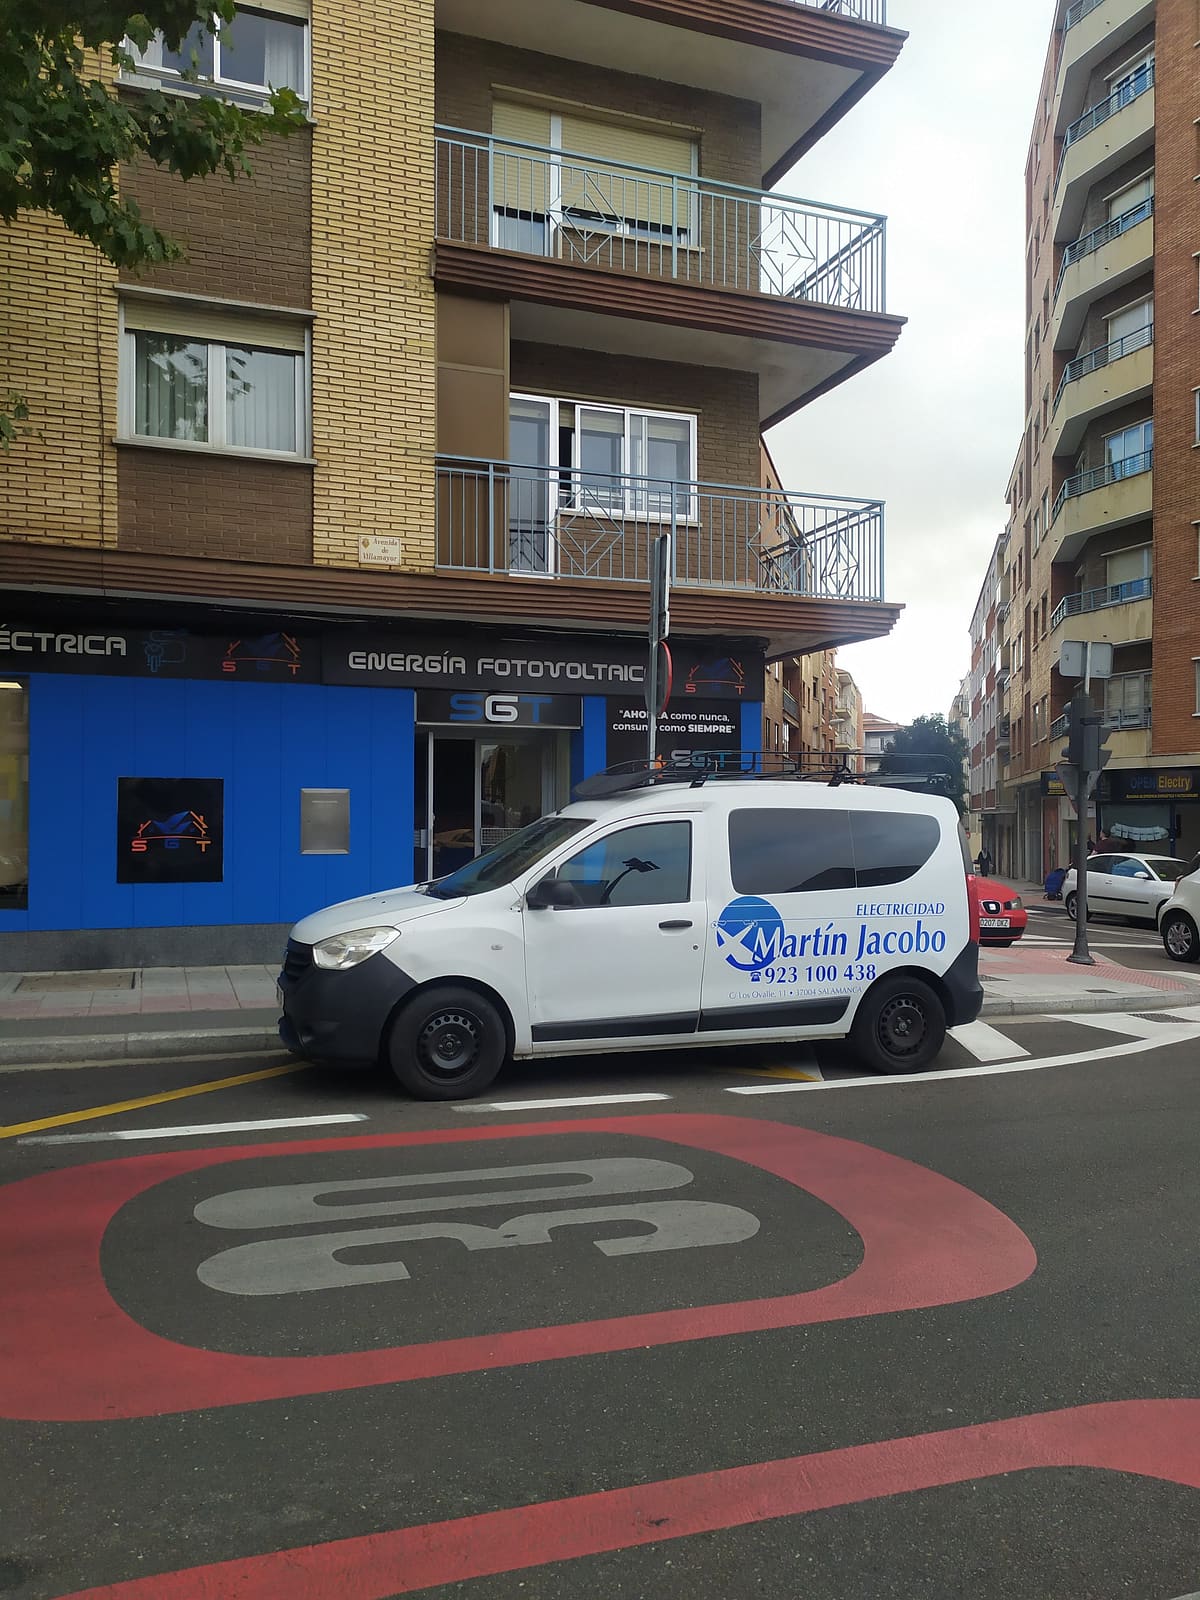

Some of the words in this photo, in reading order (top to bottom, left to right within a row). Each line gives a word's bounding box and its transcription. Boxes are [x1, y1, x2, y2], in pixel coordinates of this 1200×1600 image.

[373, 537, 398, 546] Avenida
[381, 546, 389, 554] de
[363, 551, 398, 562] Villamayor
[348, 650, 466, 675] ENERGÍA
[477, 657, 646, 682] FOTOVOLTAIC
[449, 693, 552, 723] SGT
[670, 713, 697, 721] como
[698, 713, 730, 722] nunca,
[659, 724, 687, 733] como
[687, 724, 736, 734] SIEMPRE"
[856, 902, 945, 916] ELECTRICIDAD
[752, 922, 847, 963] Martín
[855, 920, 946, 961] Jacobo
[764, 967, 798, 984] 923
[805, 965, 837, 982] 100
[843, 964, 876, 981] 438
[817, 986, 863, 995] SALAMANCA
[193, 1157, 761, 1296] 30
